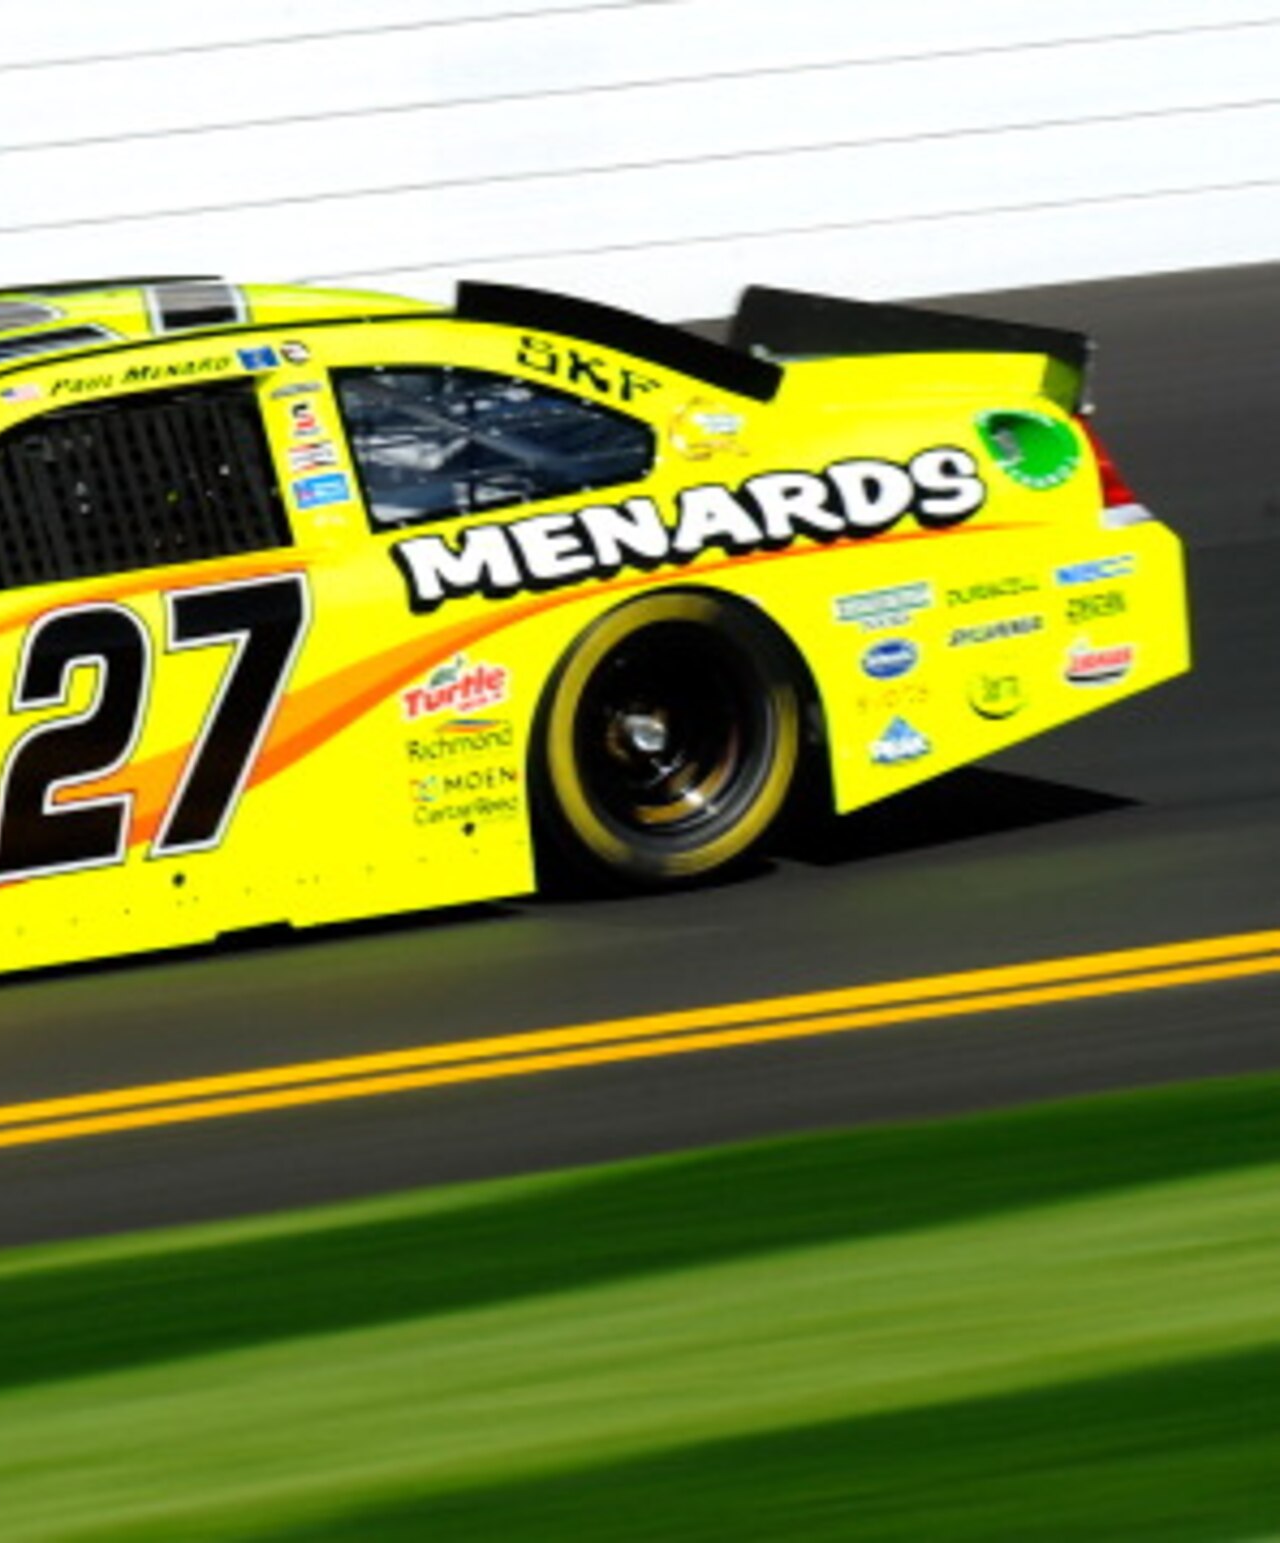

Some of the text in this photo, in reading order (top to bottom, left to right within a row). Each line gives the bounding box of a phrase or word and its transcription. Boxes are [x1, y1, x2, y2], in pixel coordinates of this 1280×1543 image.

[517, 335, 662, 402] SKF
[390, 445, 988, 616] MENARDS
[404, 664, 506, 718] Turtle
[442, 766, 518, 797] MOEN
